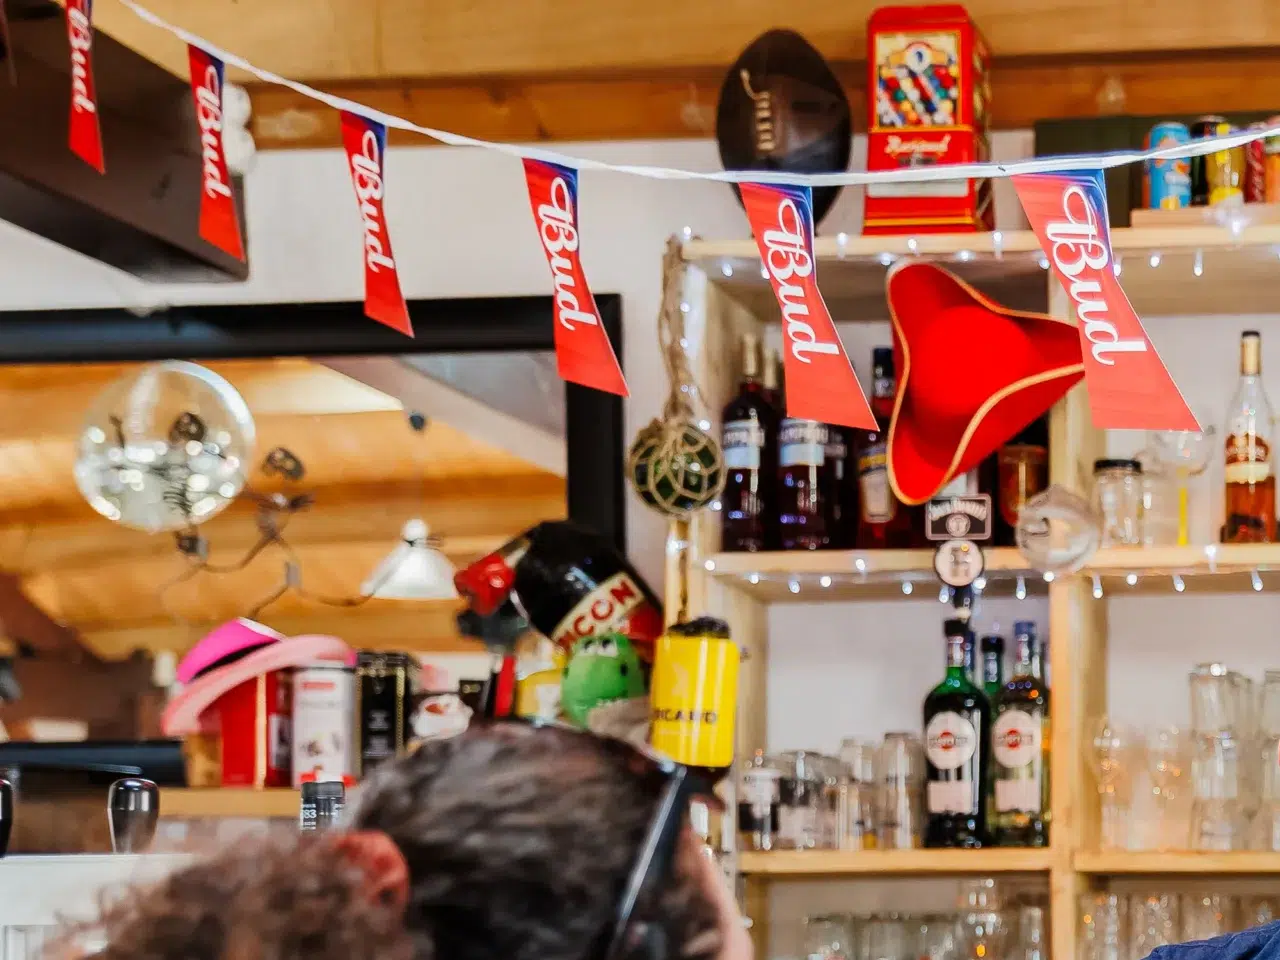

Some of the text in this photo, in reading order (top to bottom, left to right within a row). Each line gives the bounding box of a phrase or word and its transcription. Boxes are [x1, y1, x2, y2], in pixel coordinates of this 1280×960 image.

[67, 0, 95, 114] Bud
[196, 64, 231, 200] Bud
[351, 129, 395, 272] Bud
[536, 175, 597, 331] Bud
[762, 198, 838, 363] Bud
[1044, 185, 1147, 366] Bud
